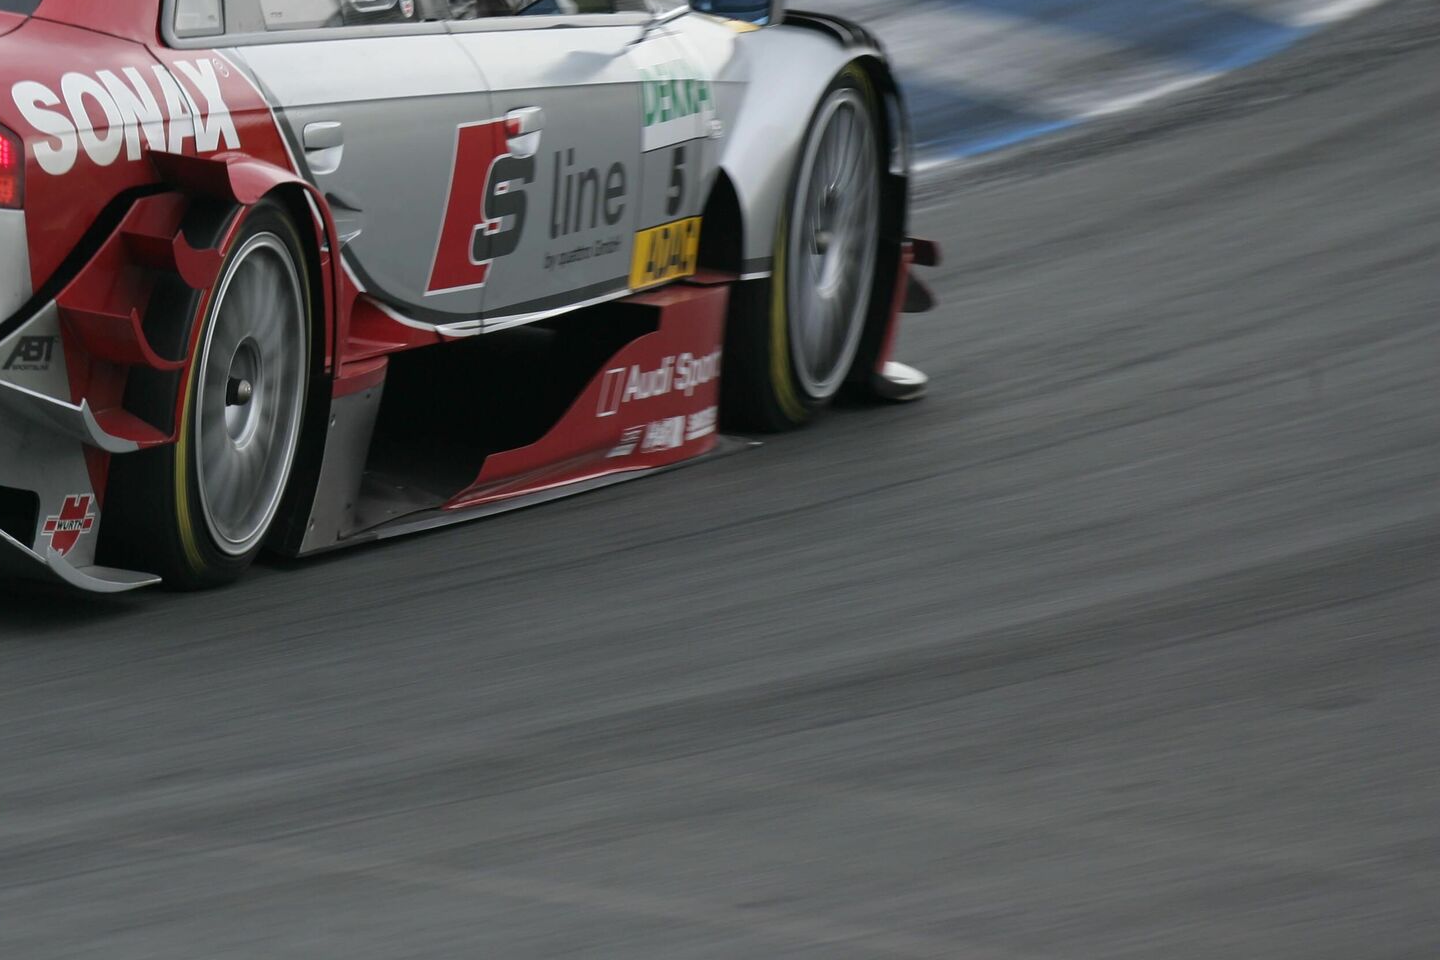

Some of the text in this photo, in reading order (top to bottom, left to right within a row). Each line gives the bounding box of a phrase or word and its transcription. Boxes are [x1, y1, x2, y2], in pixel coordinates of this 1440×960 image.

[11, 57, 241, 175] SONAX
[547, 146, 627, 240] line
[665, 144, 687, 217] 5
[1, 335, 56, 371] ABT
[621, 355, 676, 403] Audi
